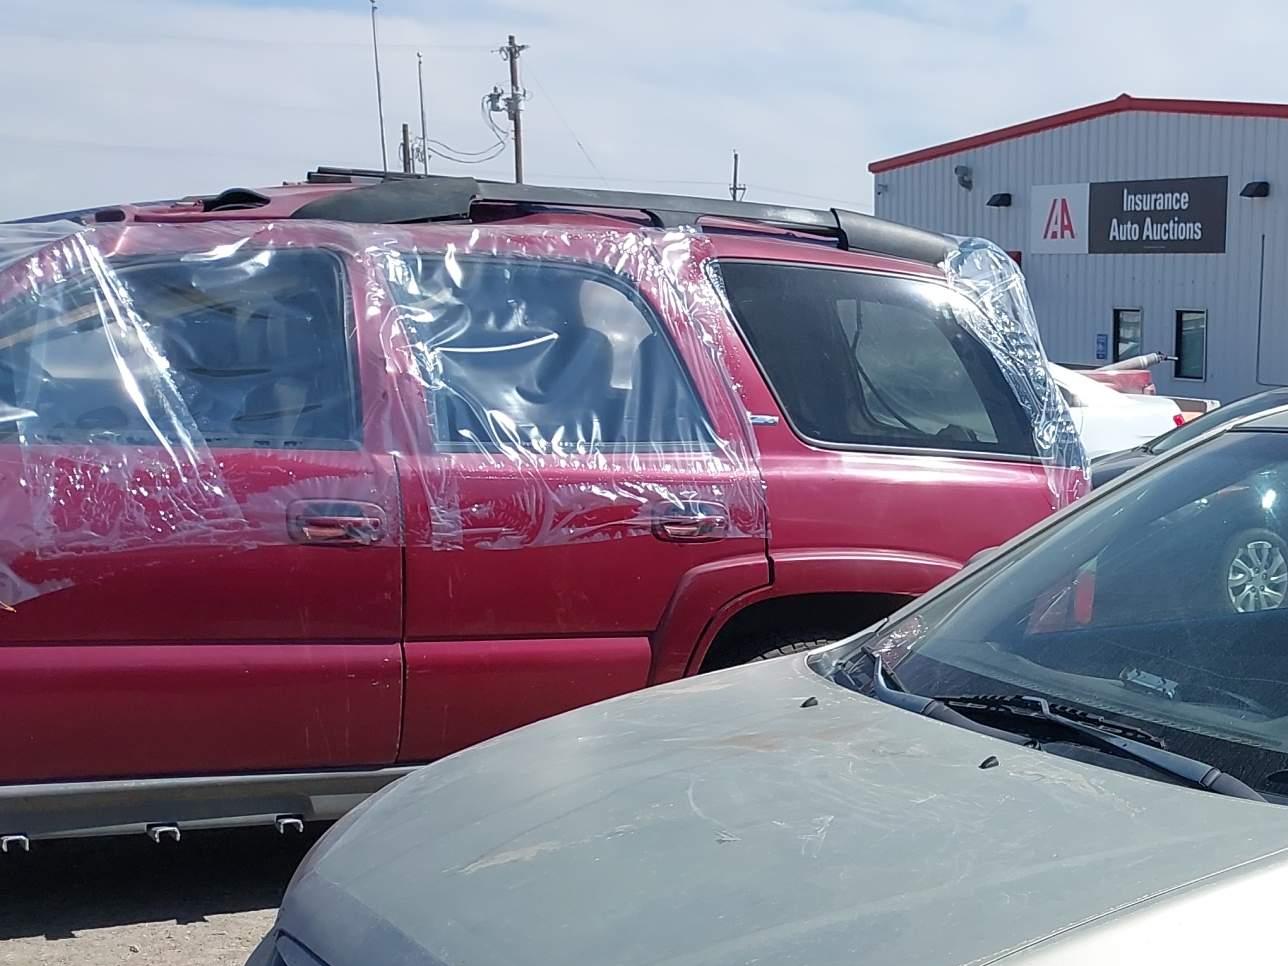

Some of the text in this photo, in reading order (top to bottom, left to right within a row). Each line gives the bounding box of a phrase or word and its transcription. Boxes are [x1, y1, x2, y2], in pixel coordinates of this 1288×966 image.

[1123, 188, 1190, 212] Insurance
[1109, 216, 1203, 241] Auto Auctions
